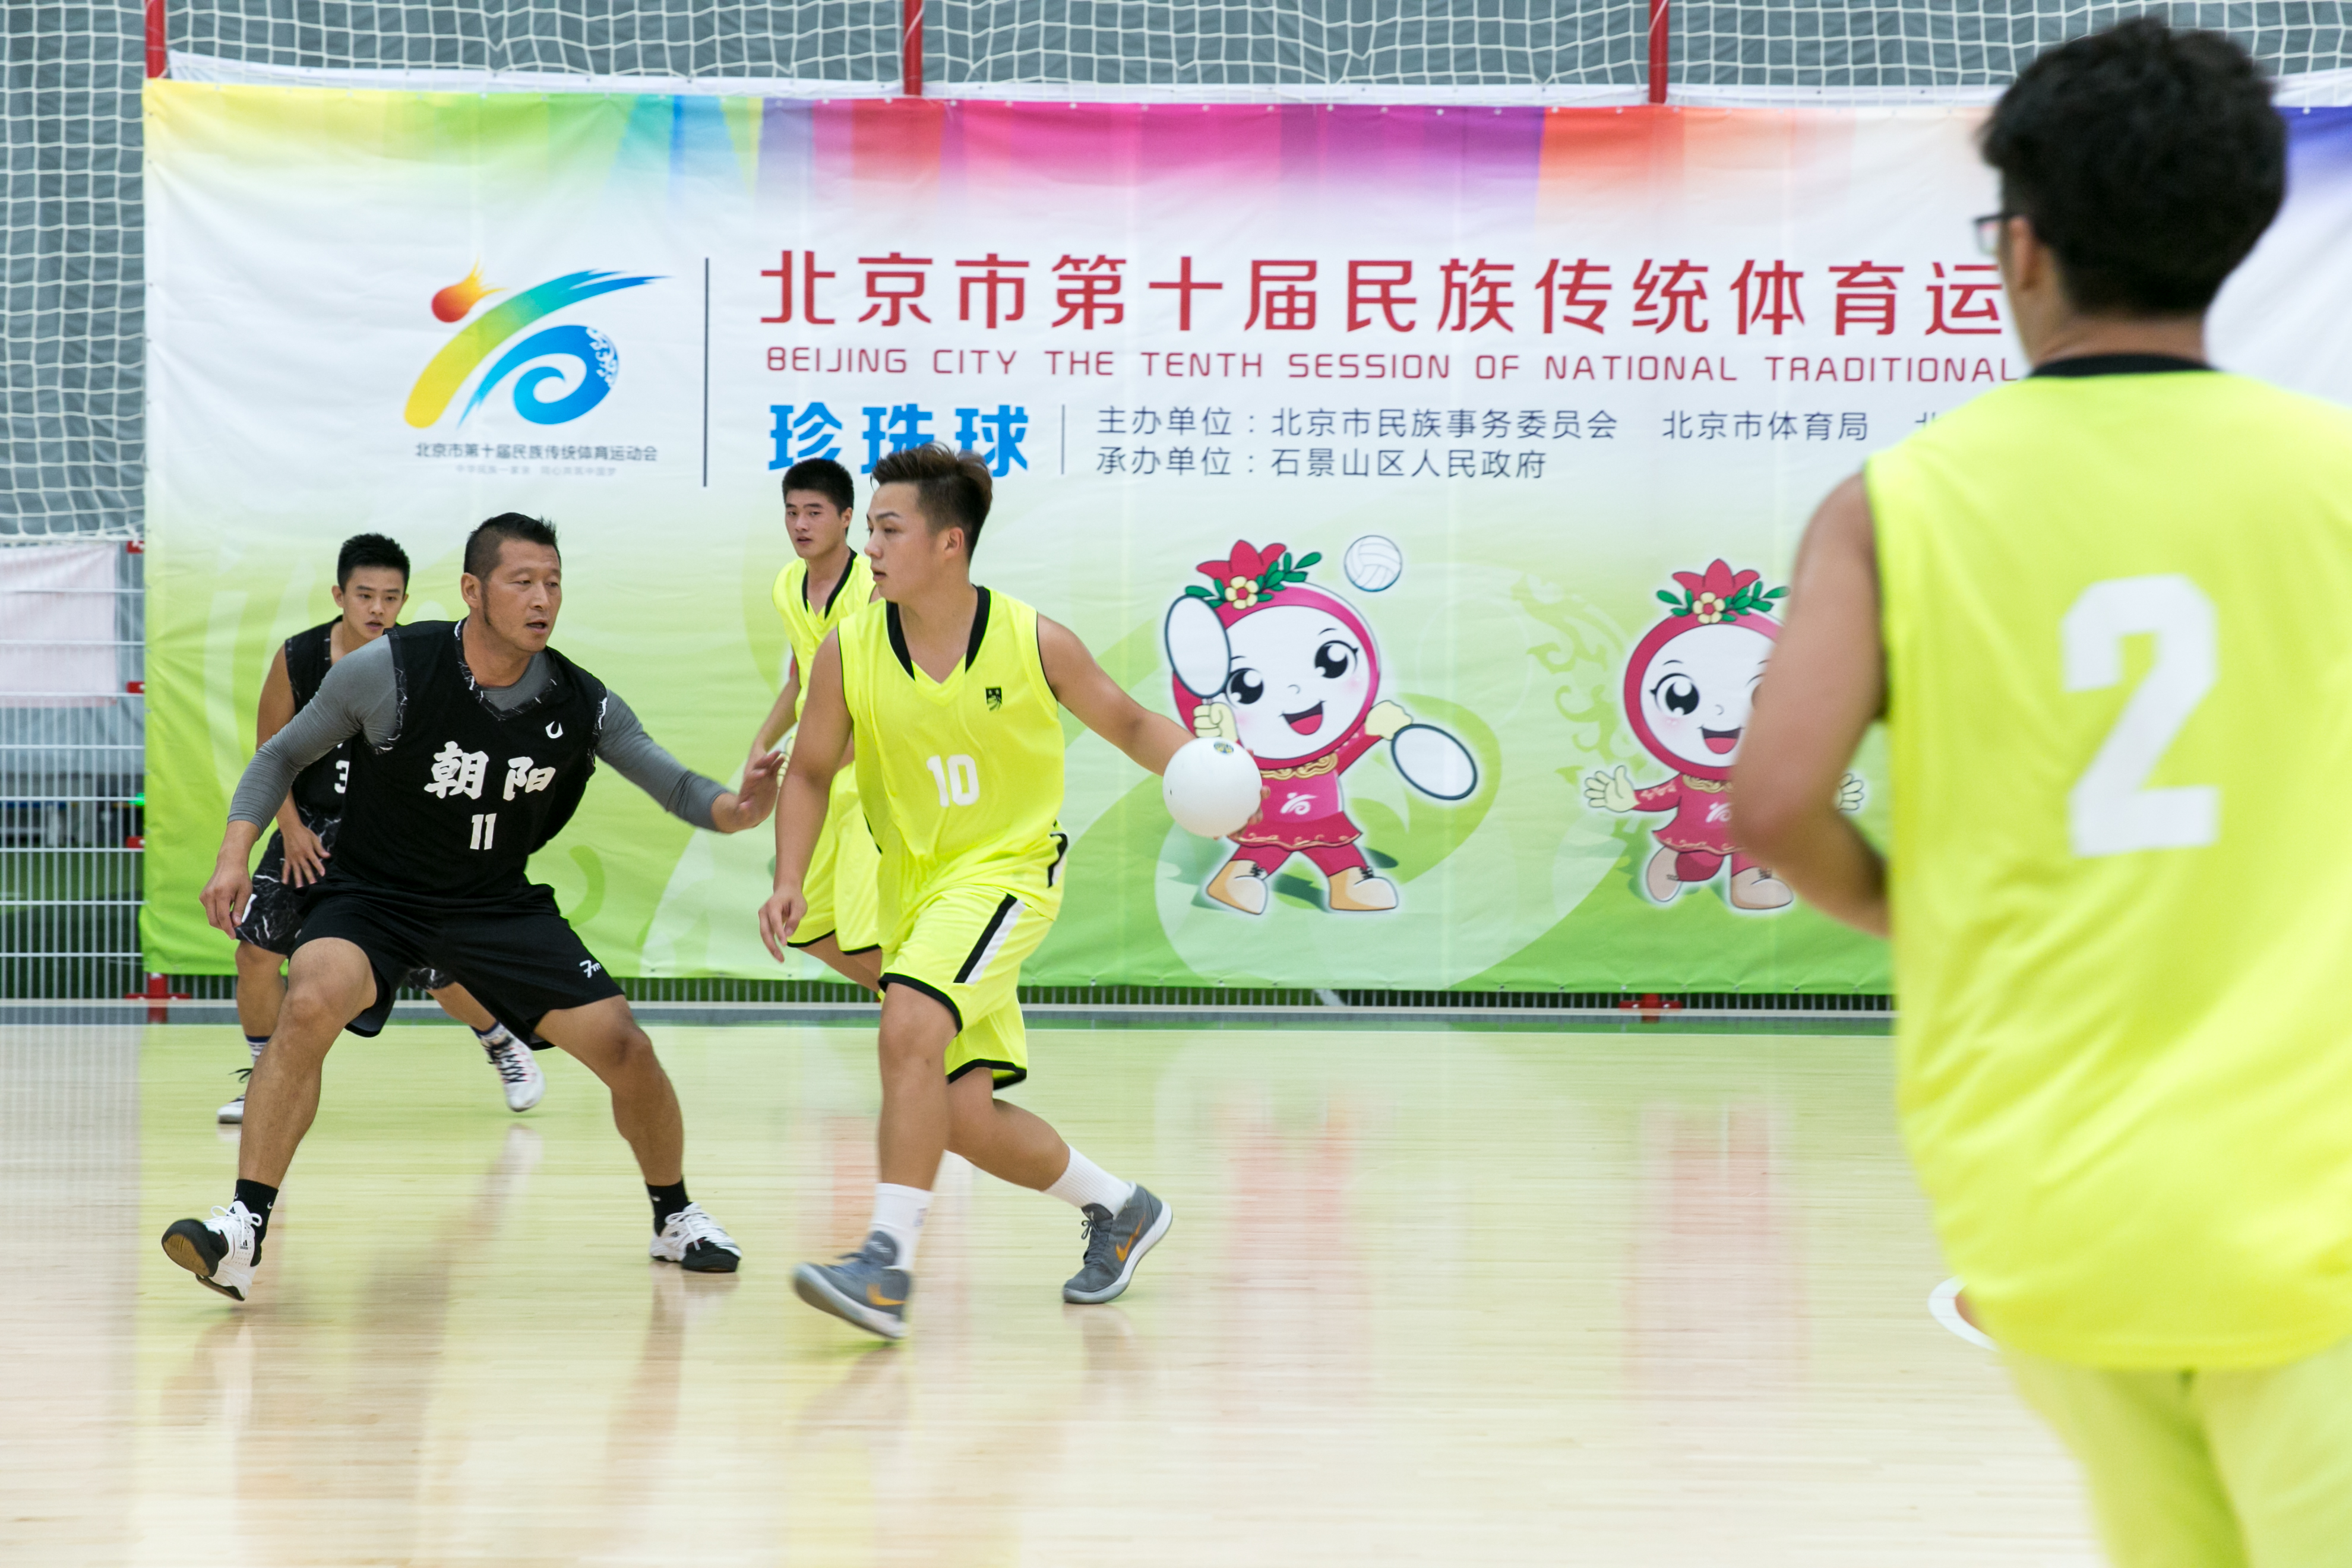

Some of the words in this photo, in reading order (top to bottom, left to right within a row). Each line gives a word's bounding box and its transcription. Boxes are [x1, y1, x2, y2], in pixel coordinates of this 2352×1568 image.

[760, 249, 2004, 336] 北京市第十届民族传统体育运
[767, 347, 907, 374] BEIJING
[933, 349, 1017, 375] CITY
[1044, 351, 1114, 376] THE
[1140, 352, 1262, 378] TENTH
[1289, 354, 1450, 380] SESSION
[1475, 355, 1519, 380] OF
[1545, 356, 1737, 381] NATIONAL
[1765, 357, 2018, 382] TRADITIONAL
[416, 443, 658, 461] 北京市第十届民族传统体育运动会
[769, 402, 1029, 478] 珍珠球
[1662, 410, 1868, 441] 北京市体育局
[2059, 571, 2221, 858] 2
[424, 741, 556, 801] 朝阳
[926, 753, 980, 807] 10
[470, 813, 497, 851] 11
